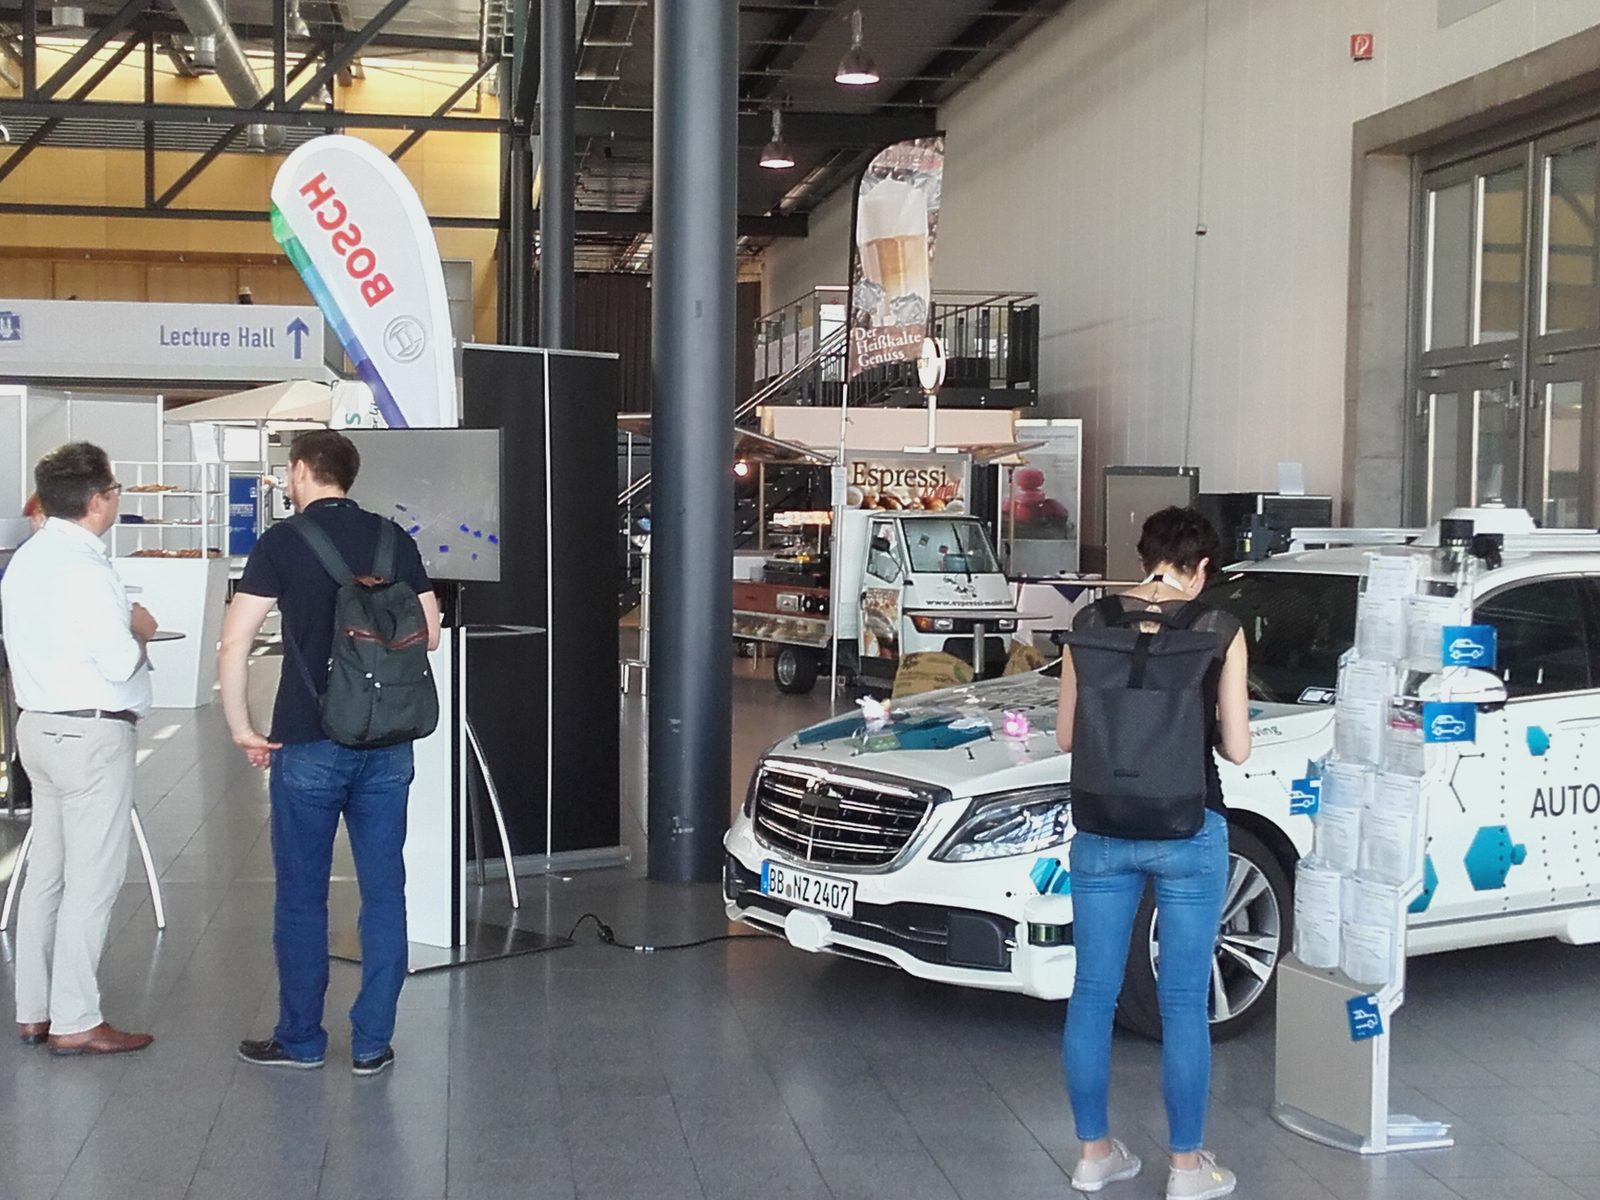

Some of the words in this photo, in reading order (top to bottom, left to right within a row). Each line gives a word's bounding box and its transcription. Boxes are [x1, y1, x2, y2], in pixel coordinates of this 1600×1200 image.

[160, 325, 230, 347] Lecture
[238, 326, 275, 348] Hall
[855, 327, 877, 341] Der
[858, 350, 904, 367] Genuss
[852, 462, 947, 493] Espressi
[1530, 783, 1600, 818] AUTO
[770, 868, 784, 894] BB
[794, 875, 810, 902] NZ
[814, 880, 849, 911] 2407
